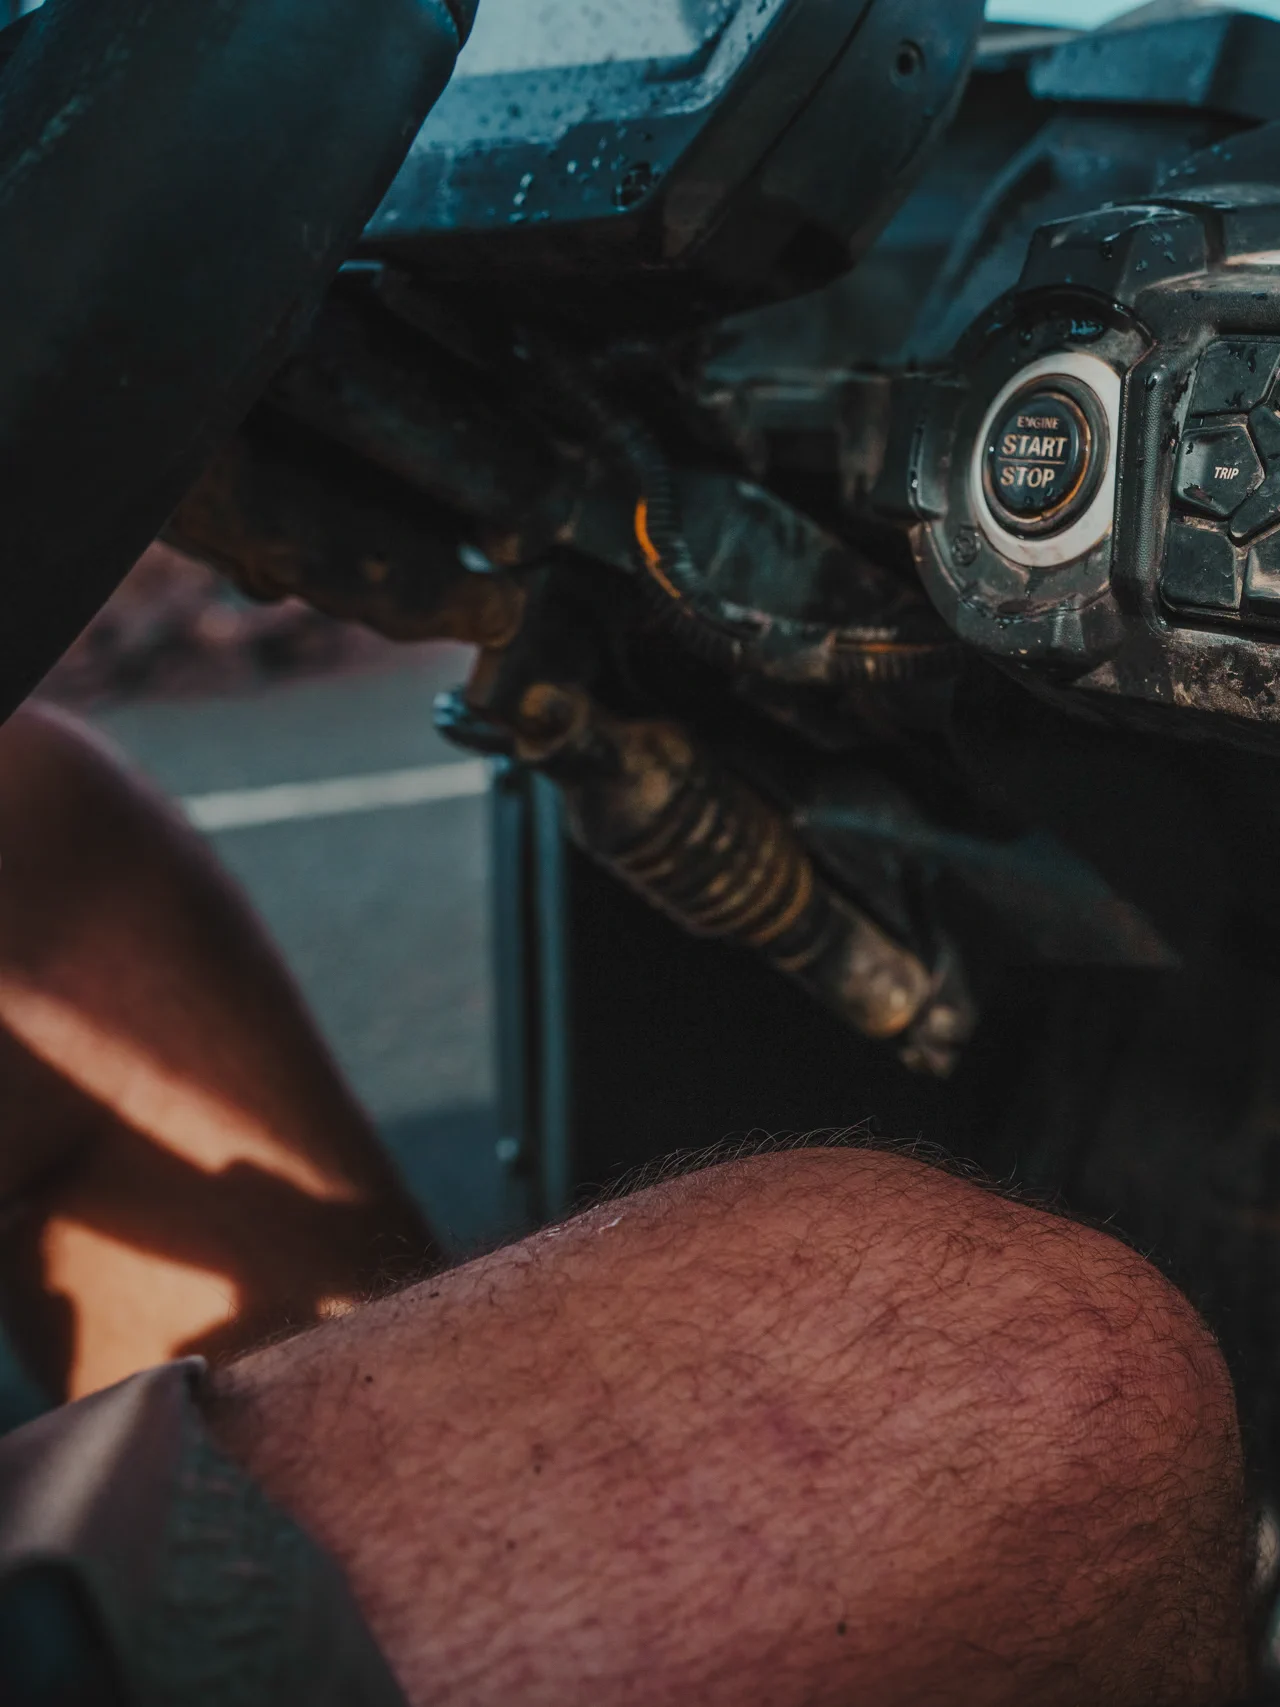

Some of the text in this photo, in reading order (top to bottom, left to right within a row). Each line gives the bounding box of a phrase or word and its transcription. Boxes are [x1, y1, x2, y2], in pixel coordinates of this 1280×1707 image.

[1017, 416, 1059, 429] ENGINE
[1001, 434, 1068, 457] START
[1000, 466, 1055, 488] STOP
[1214, 466, 1239, 480] TRIP
